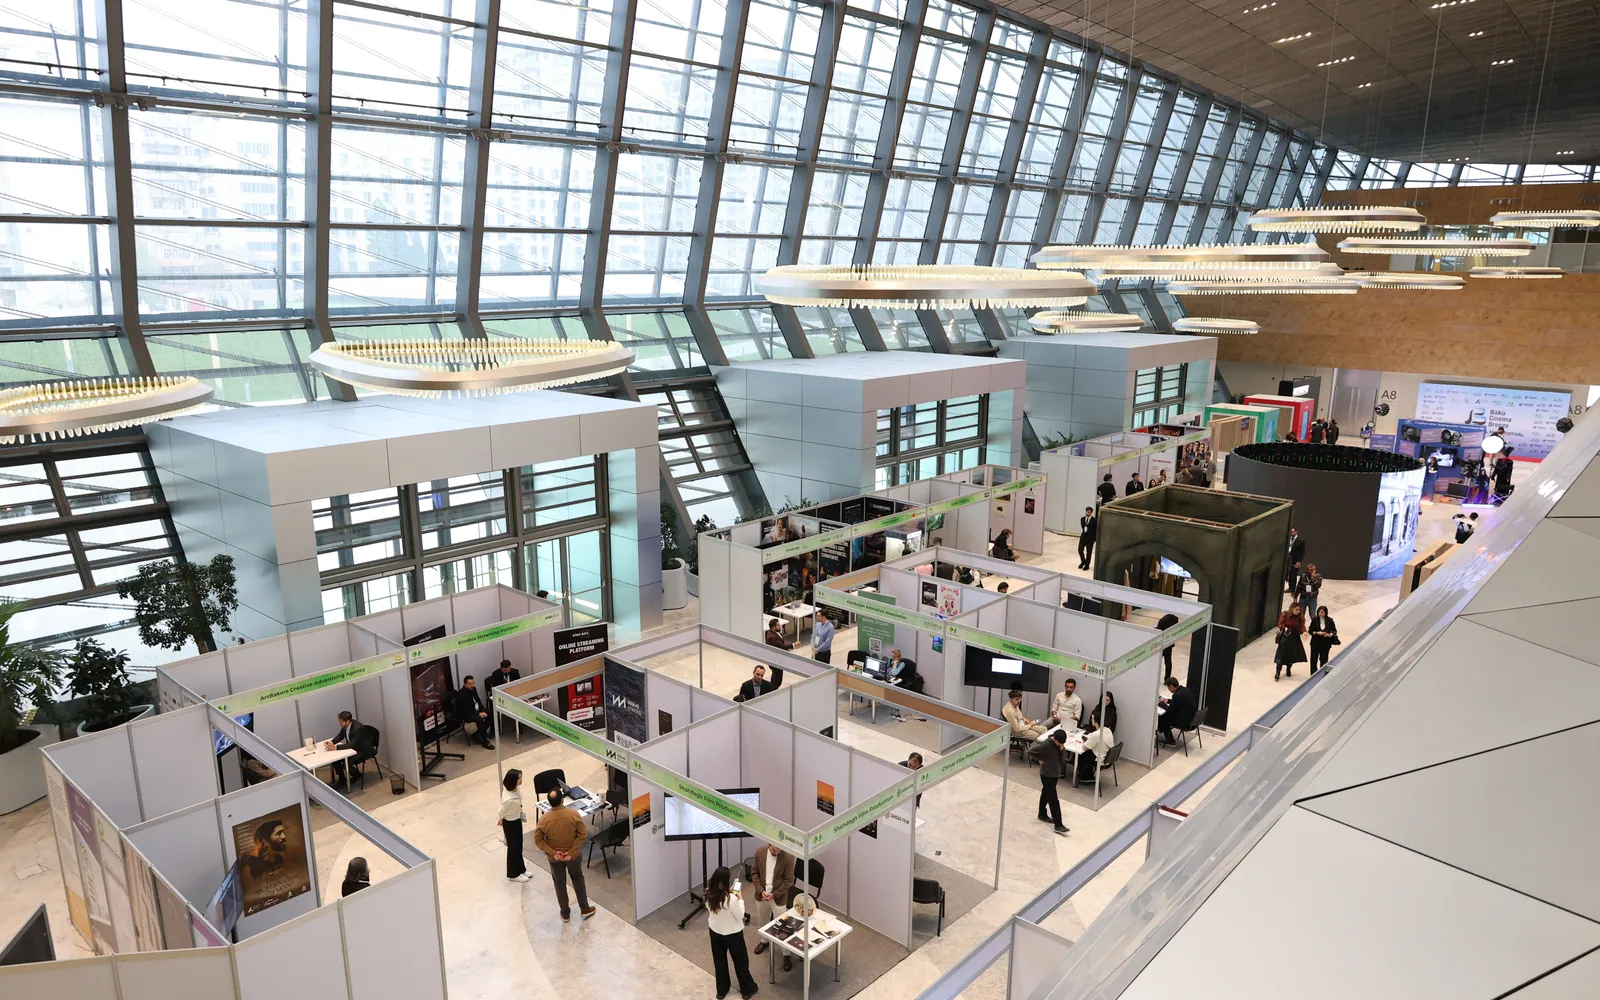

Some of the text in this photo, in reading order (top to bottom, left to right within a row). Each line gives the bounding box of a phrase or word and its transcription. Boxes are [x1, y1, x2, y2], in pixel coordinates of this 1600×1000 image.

[1381, 390, 1397, 400] A8
[1488, 421, 1510, 429] Breeze
[1489, 415, 1512, 423] Cinema
[872, 503, 892, 512] DIAMOND
[865, 604, 885, 613] Animation
[885, 609, 907, 620] Association
[477, 630, 500, 641] Streaming
[500, 624, 519, 633] Platform
[923, 621, 943, 631] anima
[558, 637, 605, 650] ONLINE STREAMING
[569, 645, 595, 654] PLATFORM
[1016, 646, 1040, 657] Animation
[260, 667, 366, 701] ArtBakers Creative Advertising Agency
[535, 716, 580, 740] Wave Media Production
[955, 756, 965, 764] Film
[965, 745, 987, 759] Production
[678, 783, 744, 819] Shahdagh Film Production
[833, 795, 894, 833] Shahdagh Film Production
